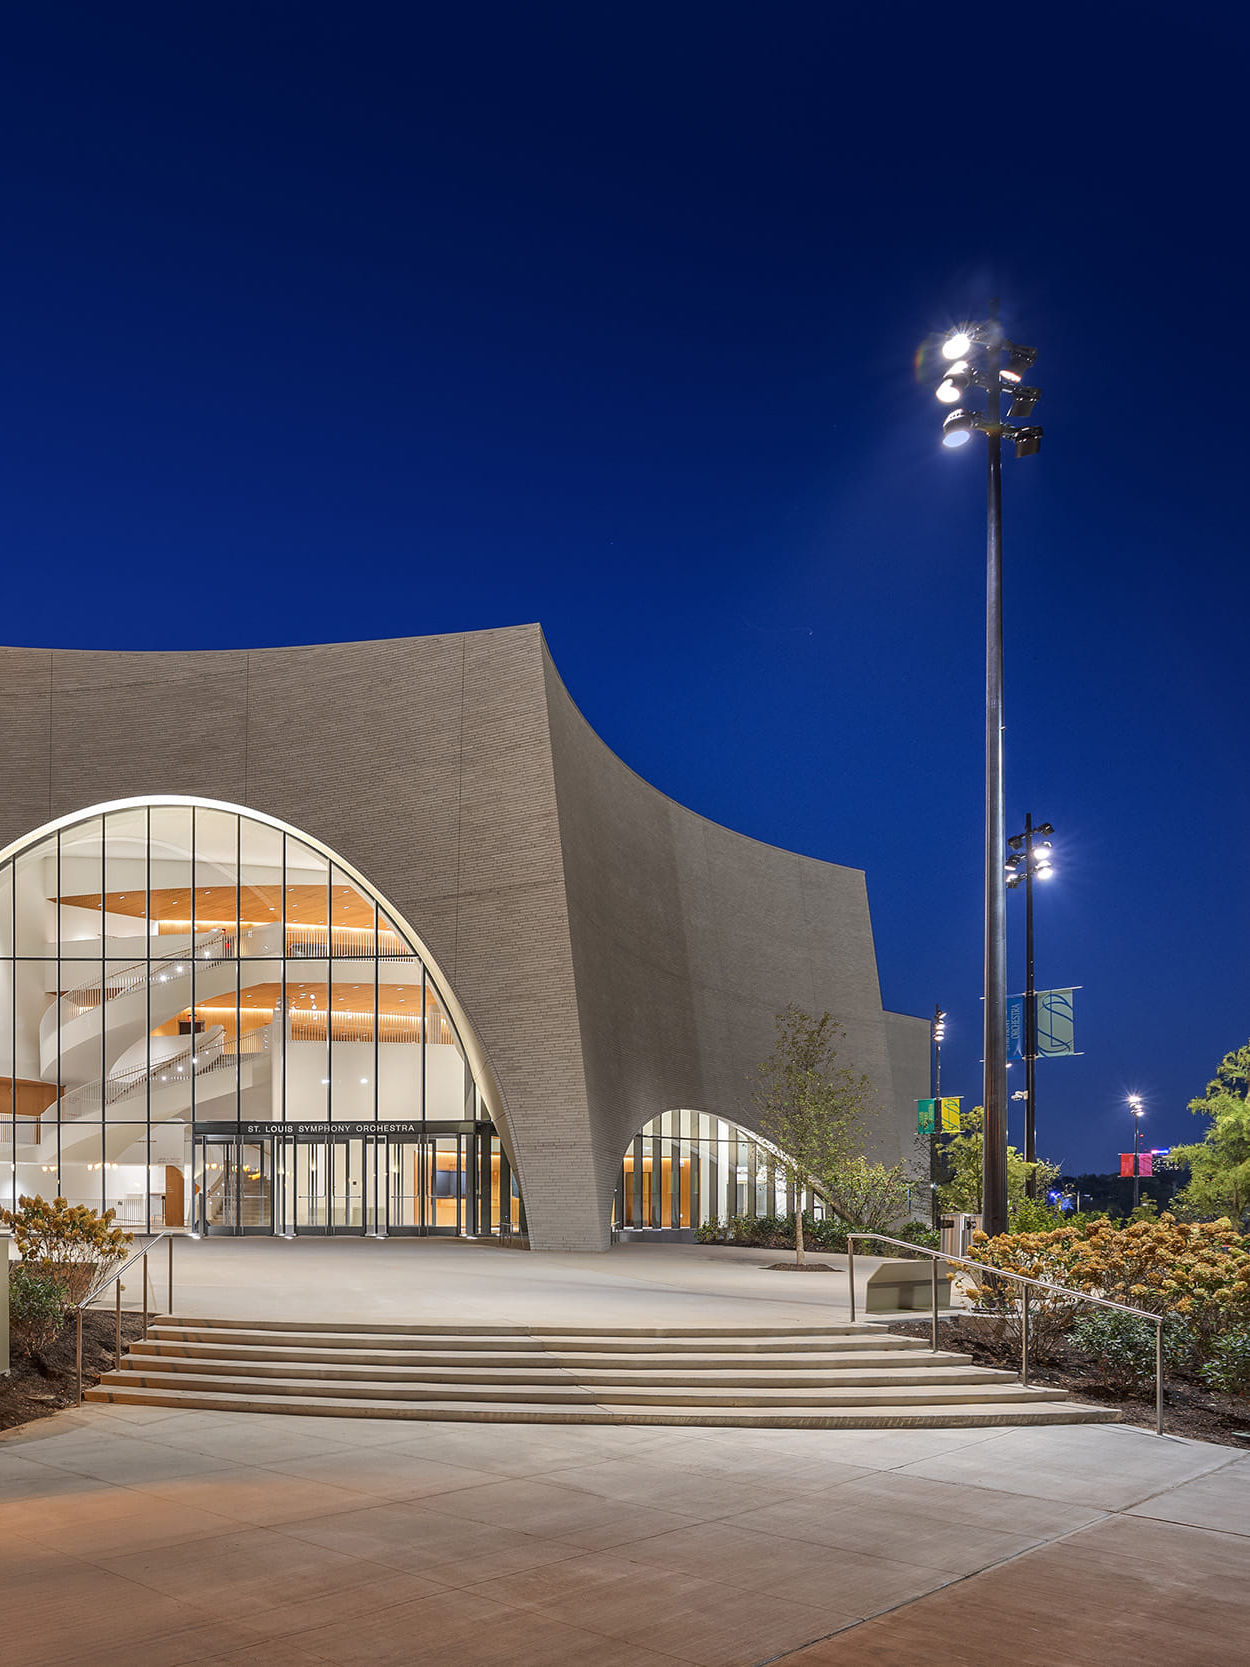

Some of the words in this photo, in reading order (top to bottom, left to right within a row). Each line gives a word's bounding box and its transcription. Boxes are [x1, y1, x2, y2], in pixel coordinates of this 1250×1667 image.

[247, 1125, 261, 1133] ST.
[265, 1125, 293, 1133] LOUIS
[298, 1124, 350, 1133] SYMPHONY
[355, 1124, 415, 1132] ORCHESTRA
